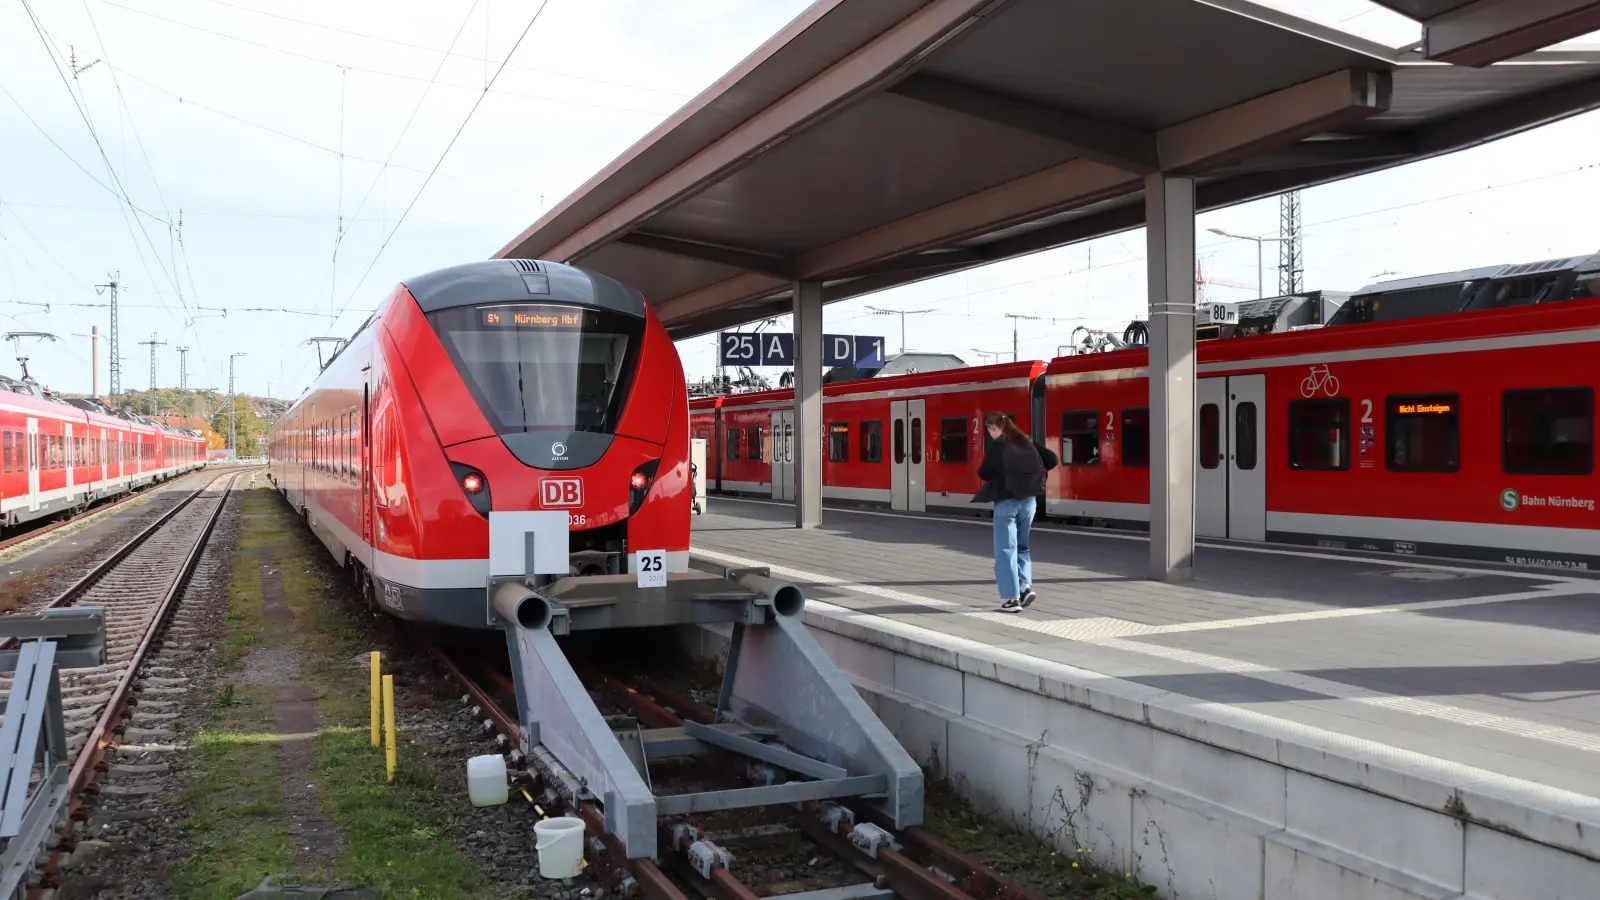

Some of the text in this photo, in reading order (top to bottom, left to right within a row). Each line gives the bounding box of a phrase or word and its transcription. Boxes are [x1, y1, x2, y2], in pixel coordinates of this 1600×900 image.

[487, 313, 578, 326] S4 Nürnberg Hbf
[1213, 304, 1235, 321] 80 m
[725, 335, 754, 359] 25
[767, 335, 785, 359] A
[834, 337, 850, 360] D
[872, 339, 881, 362] 1
[1361, 398, 1373, 423] 2
[1399, 404, 1450, 413] Nicht Einsteigen
[973, 417, 979, 434] 2
[1106, 411, 1114, 430] 2
[545, 481, 579, 503] DB
[1503, 490, 1595, 511] S Bahn Nürnberg
[641, 556, 663, 572] 25
